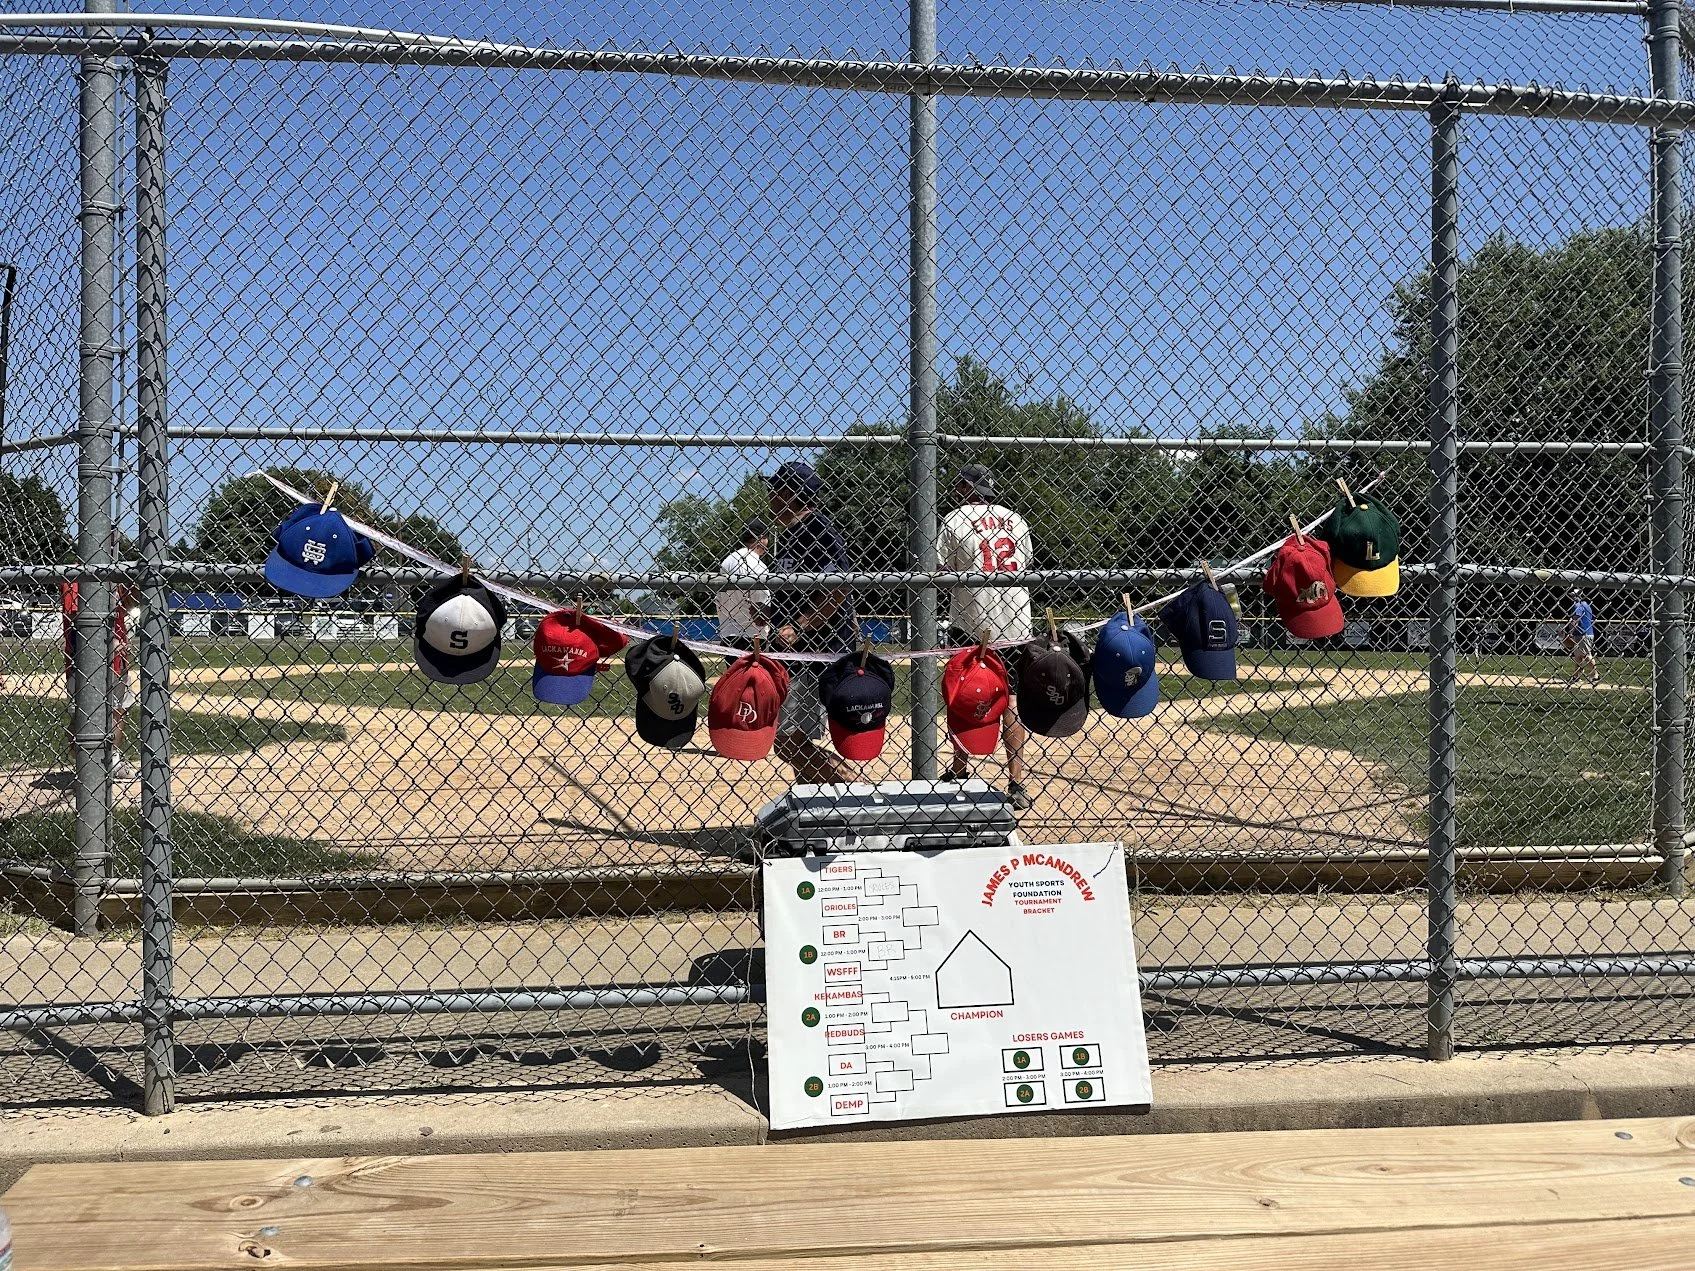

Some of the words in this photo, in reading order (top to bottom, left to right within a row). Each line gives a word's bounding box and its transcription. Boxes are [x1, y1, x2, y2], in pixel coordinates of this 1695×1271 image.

[979, 538, 1018, 572] 12
[1366, 541, 1380, 560] L
[1209, 620, 1226, 643] S
[450, 630, 468, 649] S
[982, 865, 1011, 906] JAMES
[1010, 859, 1019, 870] P
[1023, 854, 1095, 901] MCANDREW
[827, 967, 858, 976] WSFFF
[814, 991, 863, 1001] KEKAMBAS
[951, 1010, 1004, 1021] CHAMPION
[825, 1029, 865, 1038] REDBUDS
[1012, 1033, 1049, 1043] LOSERS
[1050, 1031, 1084, 1040] GAMES
[836, 1100, 864, 1110] DEMP
